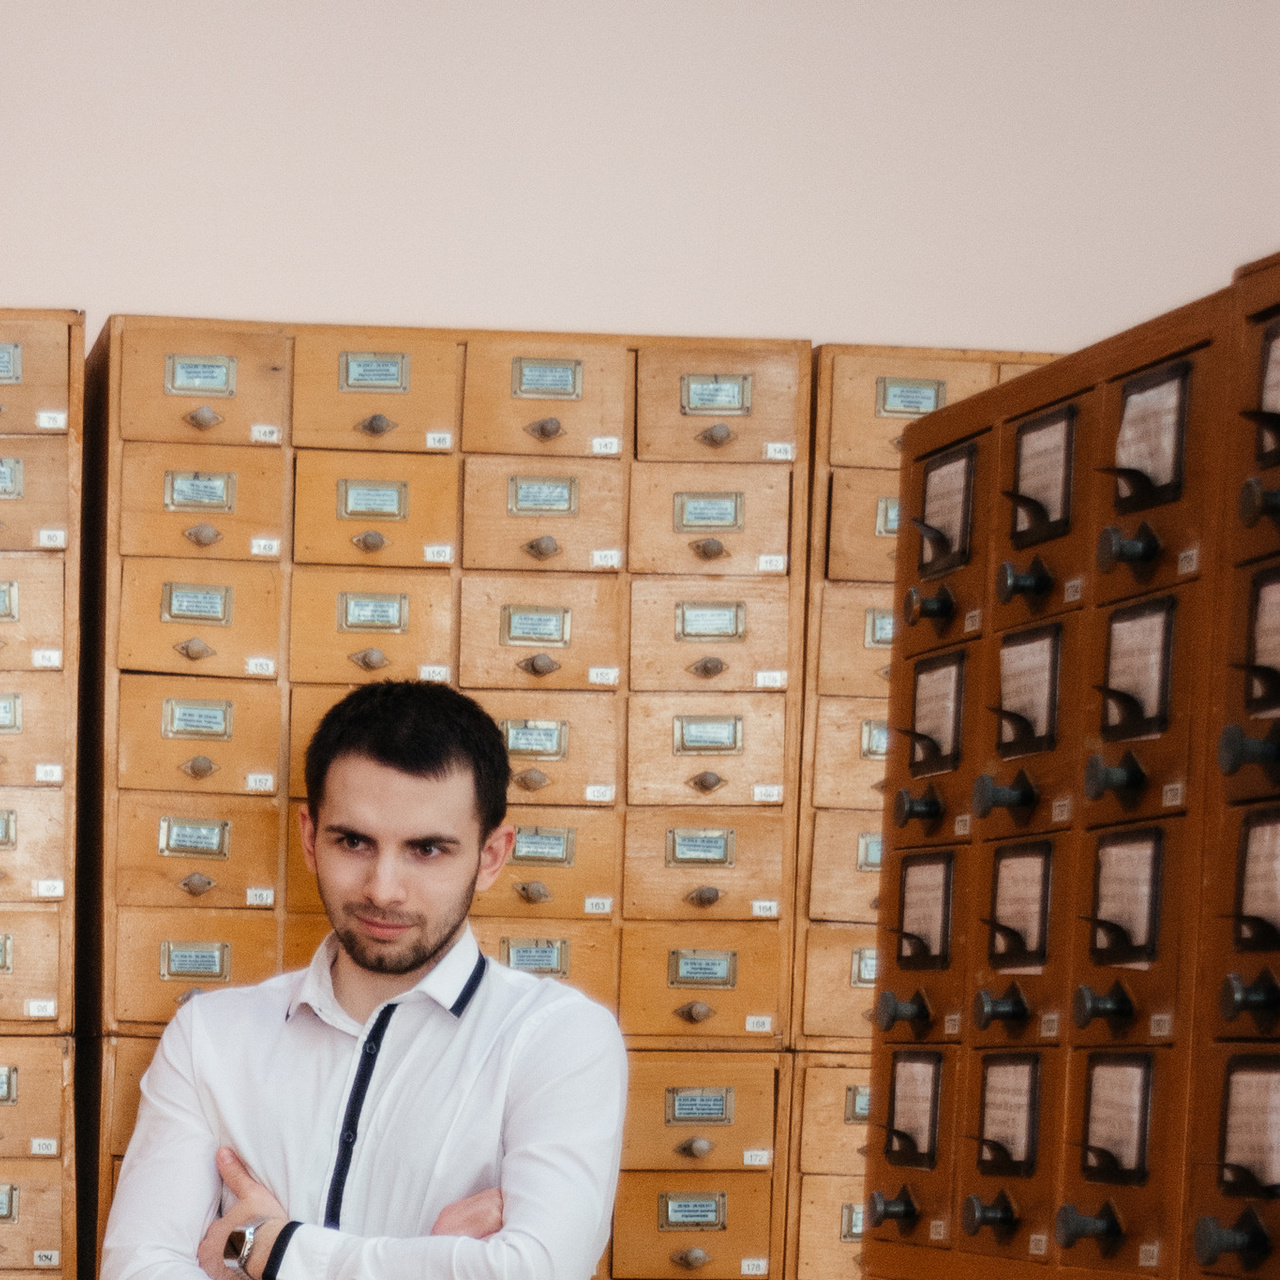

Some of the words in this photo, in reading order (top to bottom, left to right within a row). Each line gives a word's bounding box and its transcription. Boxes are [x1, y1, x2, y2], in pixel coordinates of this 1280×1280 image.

[431, 436, 448, 445] 146
[599, 441, 614, 450] 147
[257, 543, 274, 552] 149
[254, 662, 270, 672] 153
[595, 671, 611, 681] 155
[253, 777, 269, 788] 157
[590, 901, 606, 911] 163
[37, 1142, 53, 1152] 100
[748, 1153, 763, 1163] 172
[37, 1254, 53, 1263] 104
